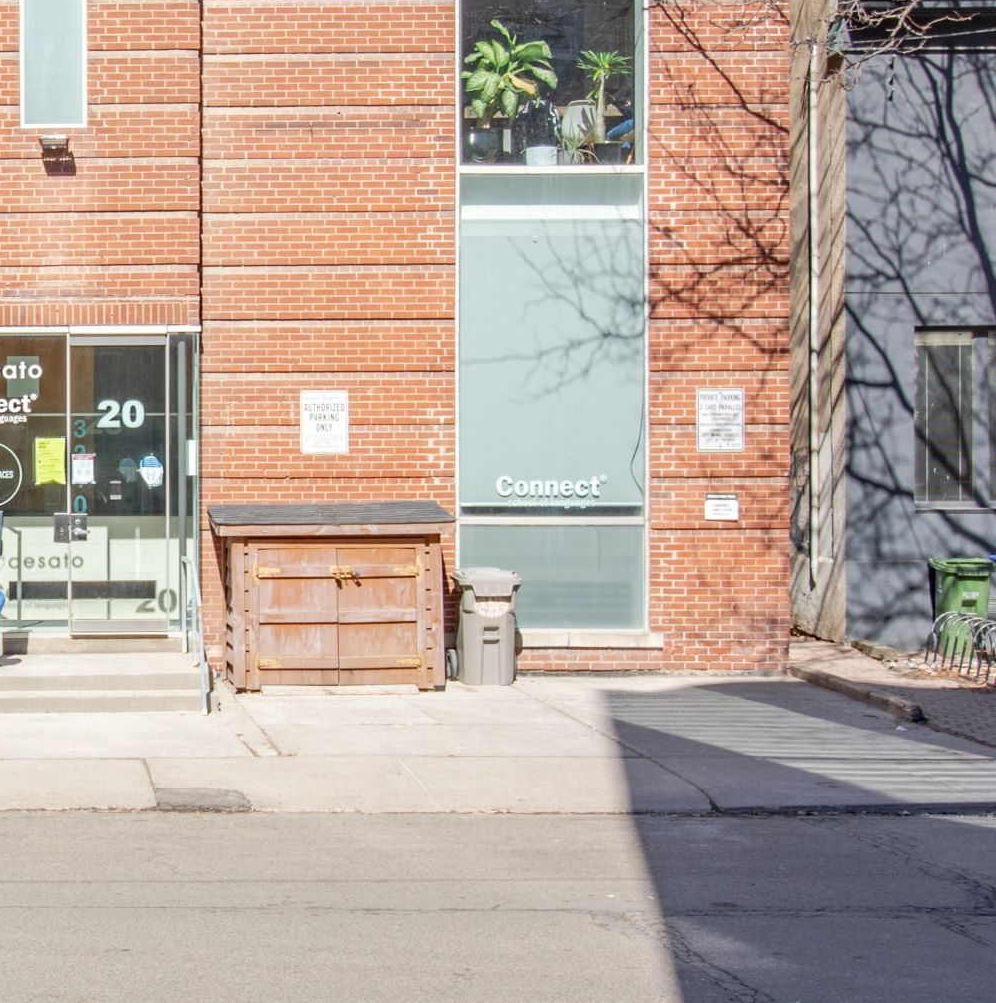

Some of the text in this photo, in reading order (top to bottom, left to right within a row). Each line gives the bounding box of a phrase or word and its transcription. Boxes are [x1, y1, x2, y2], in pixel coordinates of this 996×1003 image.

[304, 403, 345, 412] AUTHORIZED
[96, 399, 145, 428] 20
[309, 413, 340, 422] PARKING
[315, 423, 332, 432] ONLY
